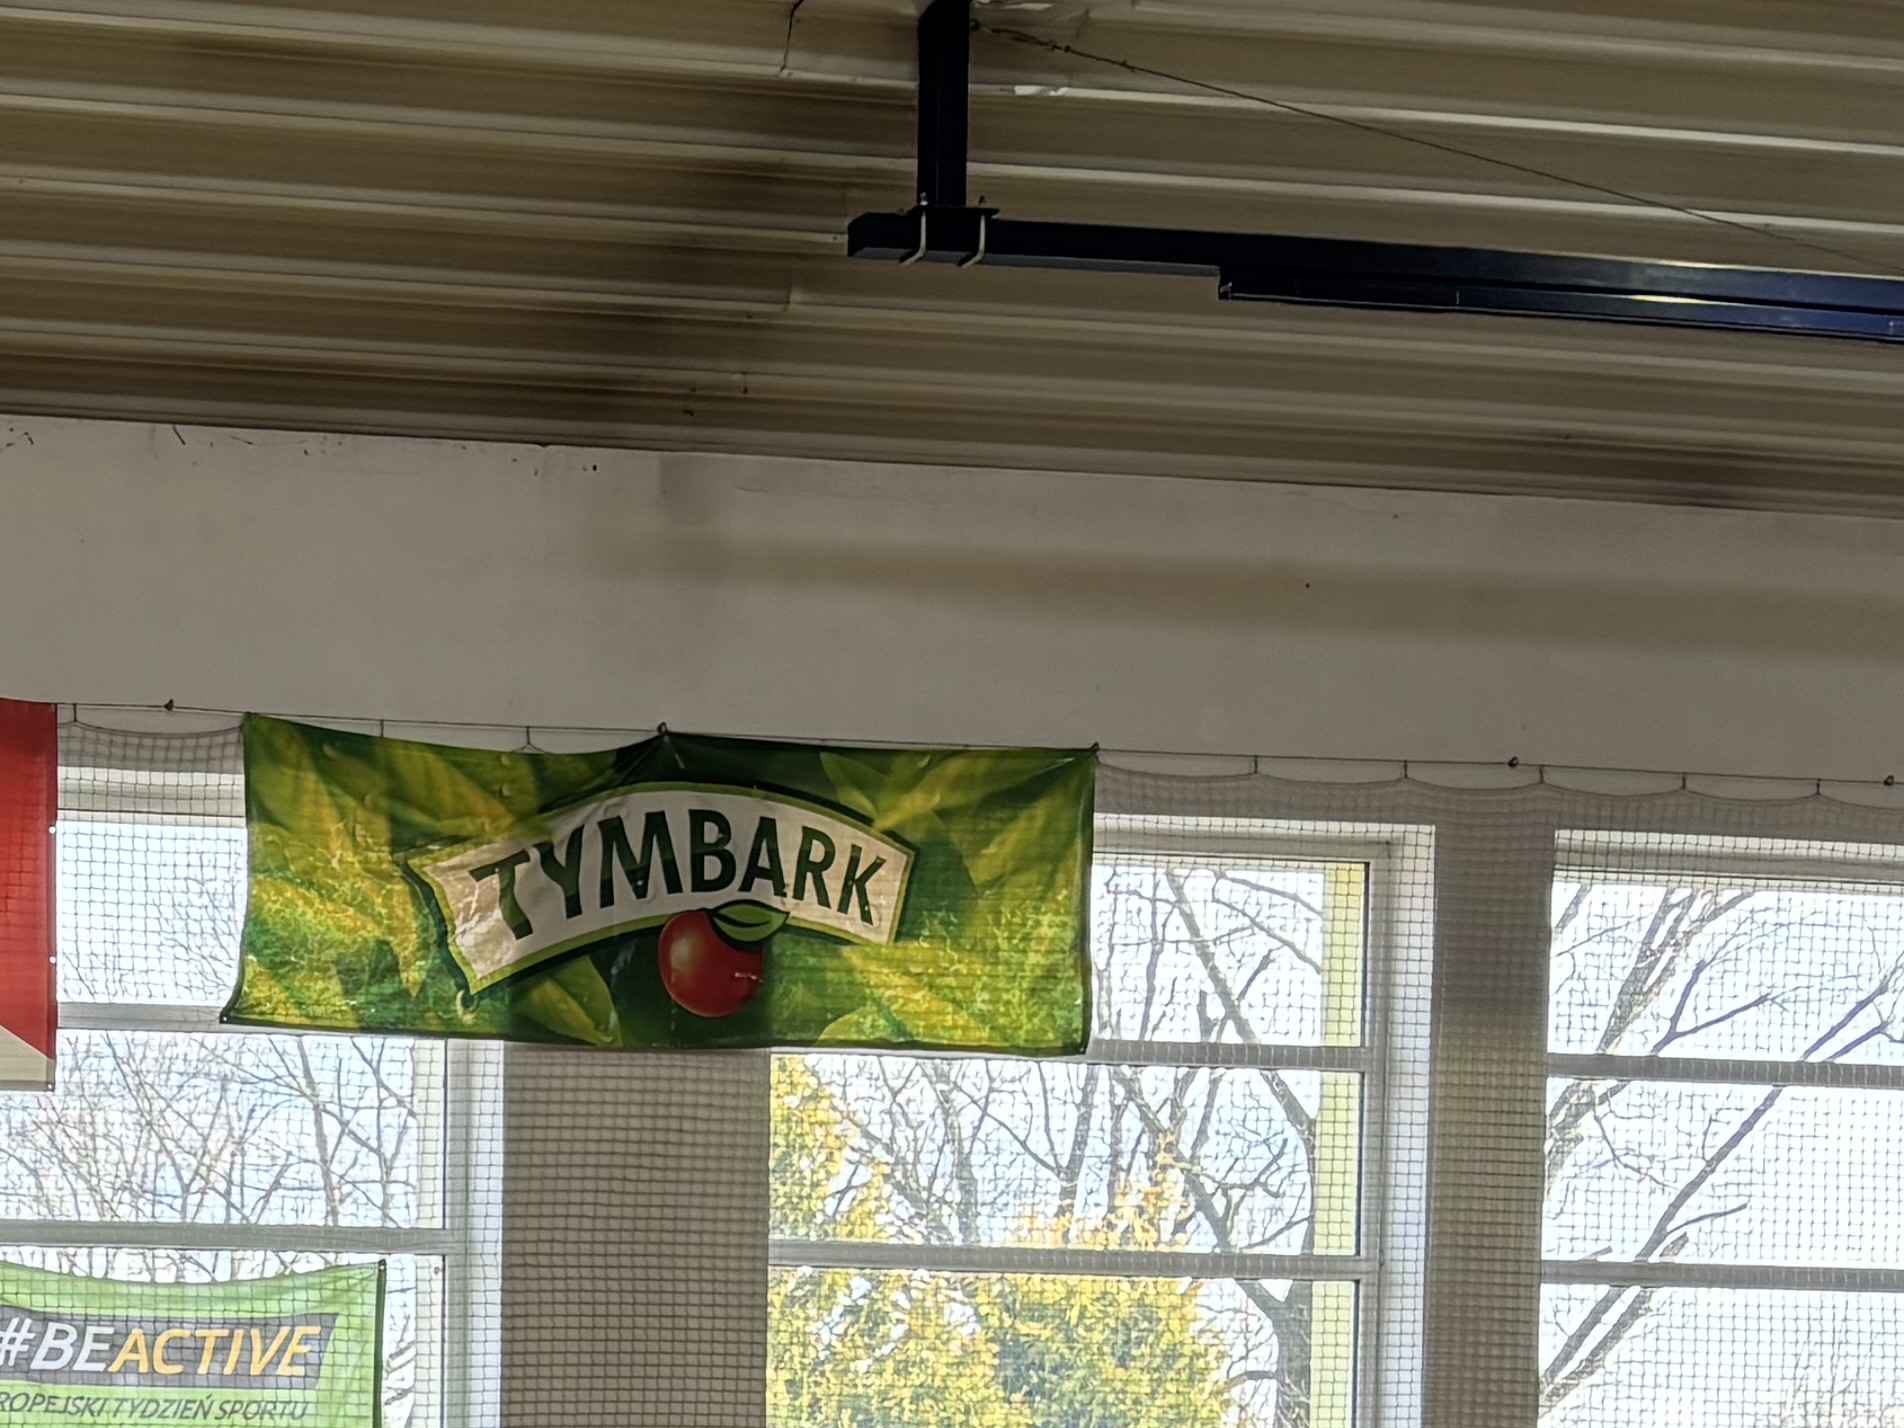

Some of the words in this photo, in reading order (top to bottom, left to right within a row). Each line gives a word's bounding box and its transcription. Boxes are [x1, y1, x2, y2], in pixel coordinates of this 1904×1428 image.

[469, 808, 887, 940] TYMBARK
[112, 1394, 212, 1420] TYDZIEŃ
[214, 1400, 309, 1420] SPORTU
